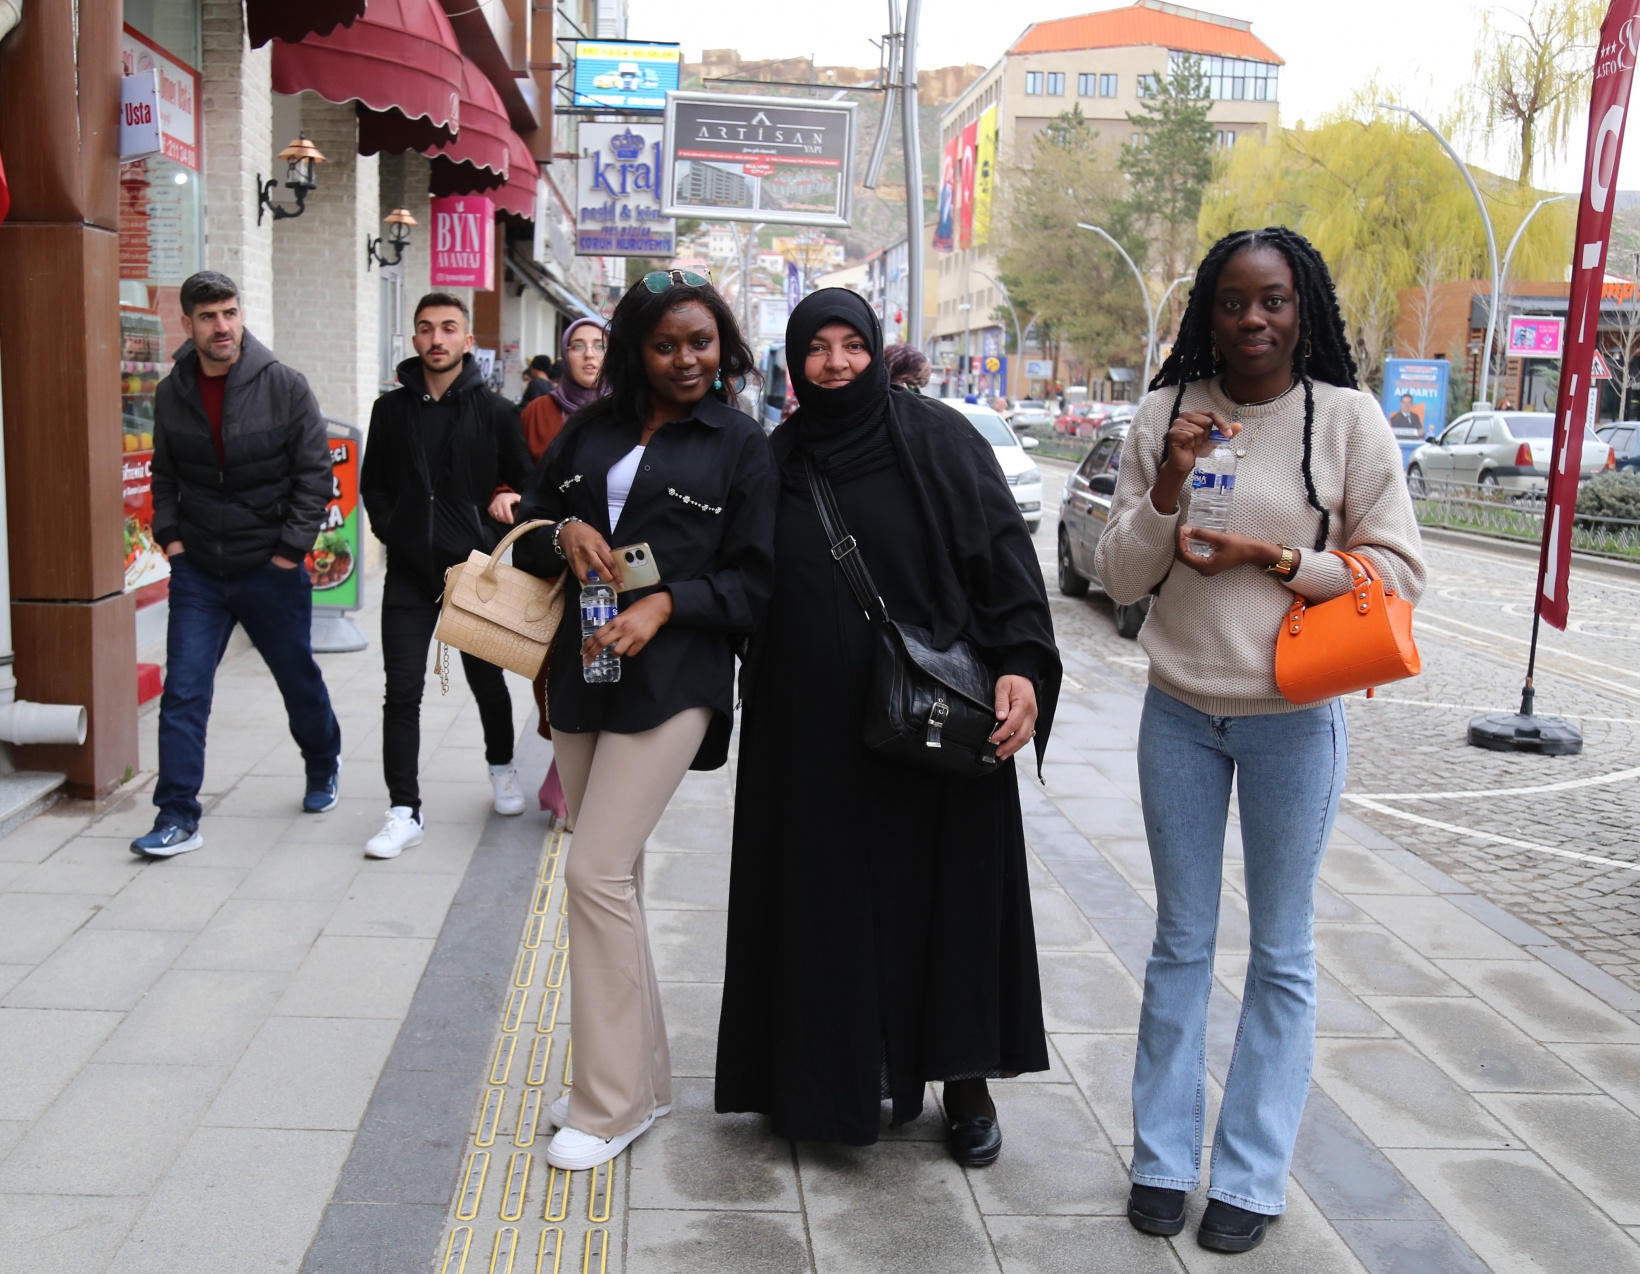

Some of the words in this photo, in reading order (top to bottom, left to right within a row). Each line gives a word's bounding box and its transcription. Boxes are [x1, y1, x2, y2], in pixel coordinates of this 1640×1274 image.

[125, 102, 151, 126] Usta
[698, 126, 823, 144] ARTİSAN
[803, 145, 822, 154] YAPI
[590, 141, 661, 200] kral
[620, 204, 631, 219] &
[437, 212, 481, 252] BYN
